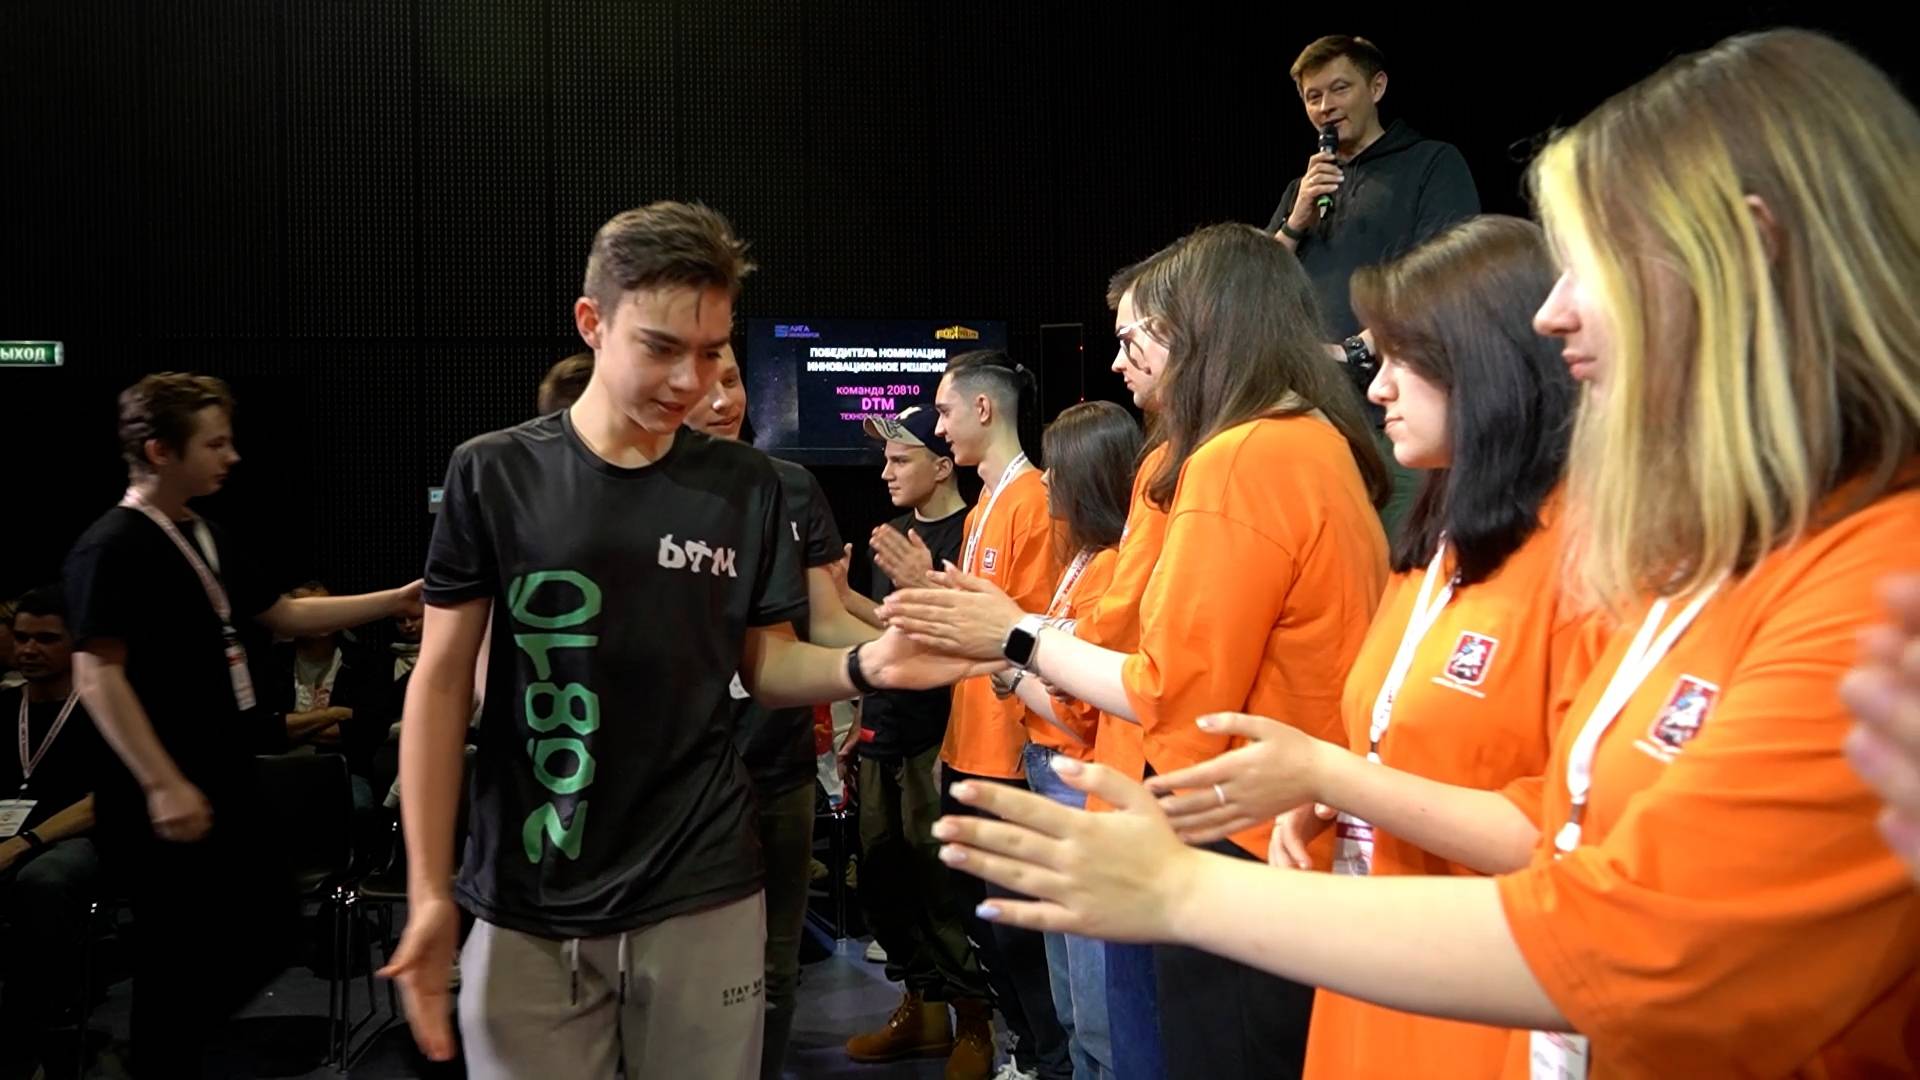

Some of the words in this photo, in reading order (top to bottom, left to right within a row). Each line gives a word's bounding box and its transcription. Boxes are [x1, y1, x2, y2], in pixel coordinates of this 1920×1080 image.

[0, 347, 46, 362] ЫХОД
[810, 347, 877, 359] ПОБЕДИТЕЛЬ
[879, 348, 946, 360] НОМИНАЦИИ
[807, 361, 898, 373] ИННОВАЦИОННОЕ
[836, 386, 884, 396] команда
[887, 385, 920, 395] 20810
[862, 398, 895, 410] DTM
[508, 569, 602, 864] 20810
